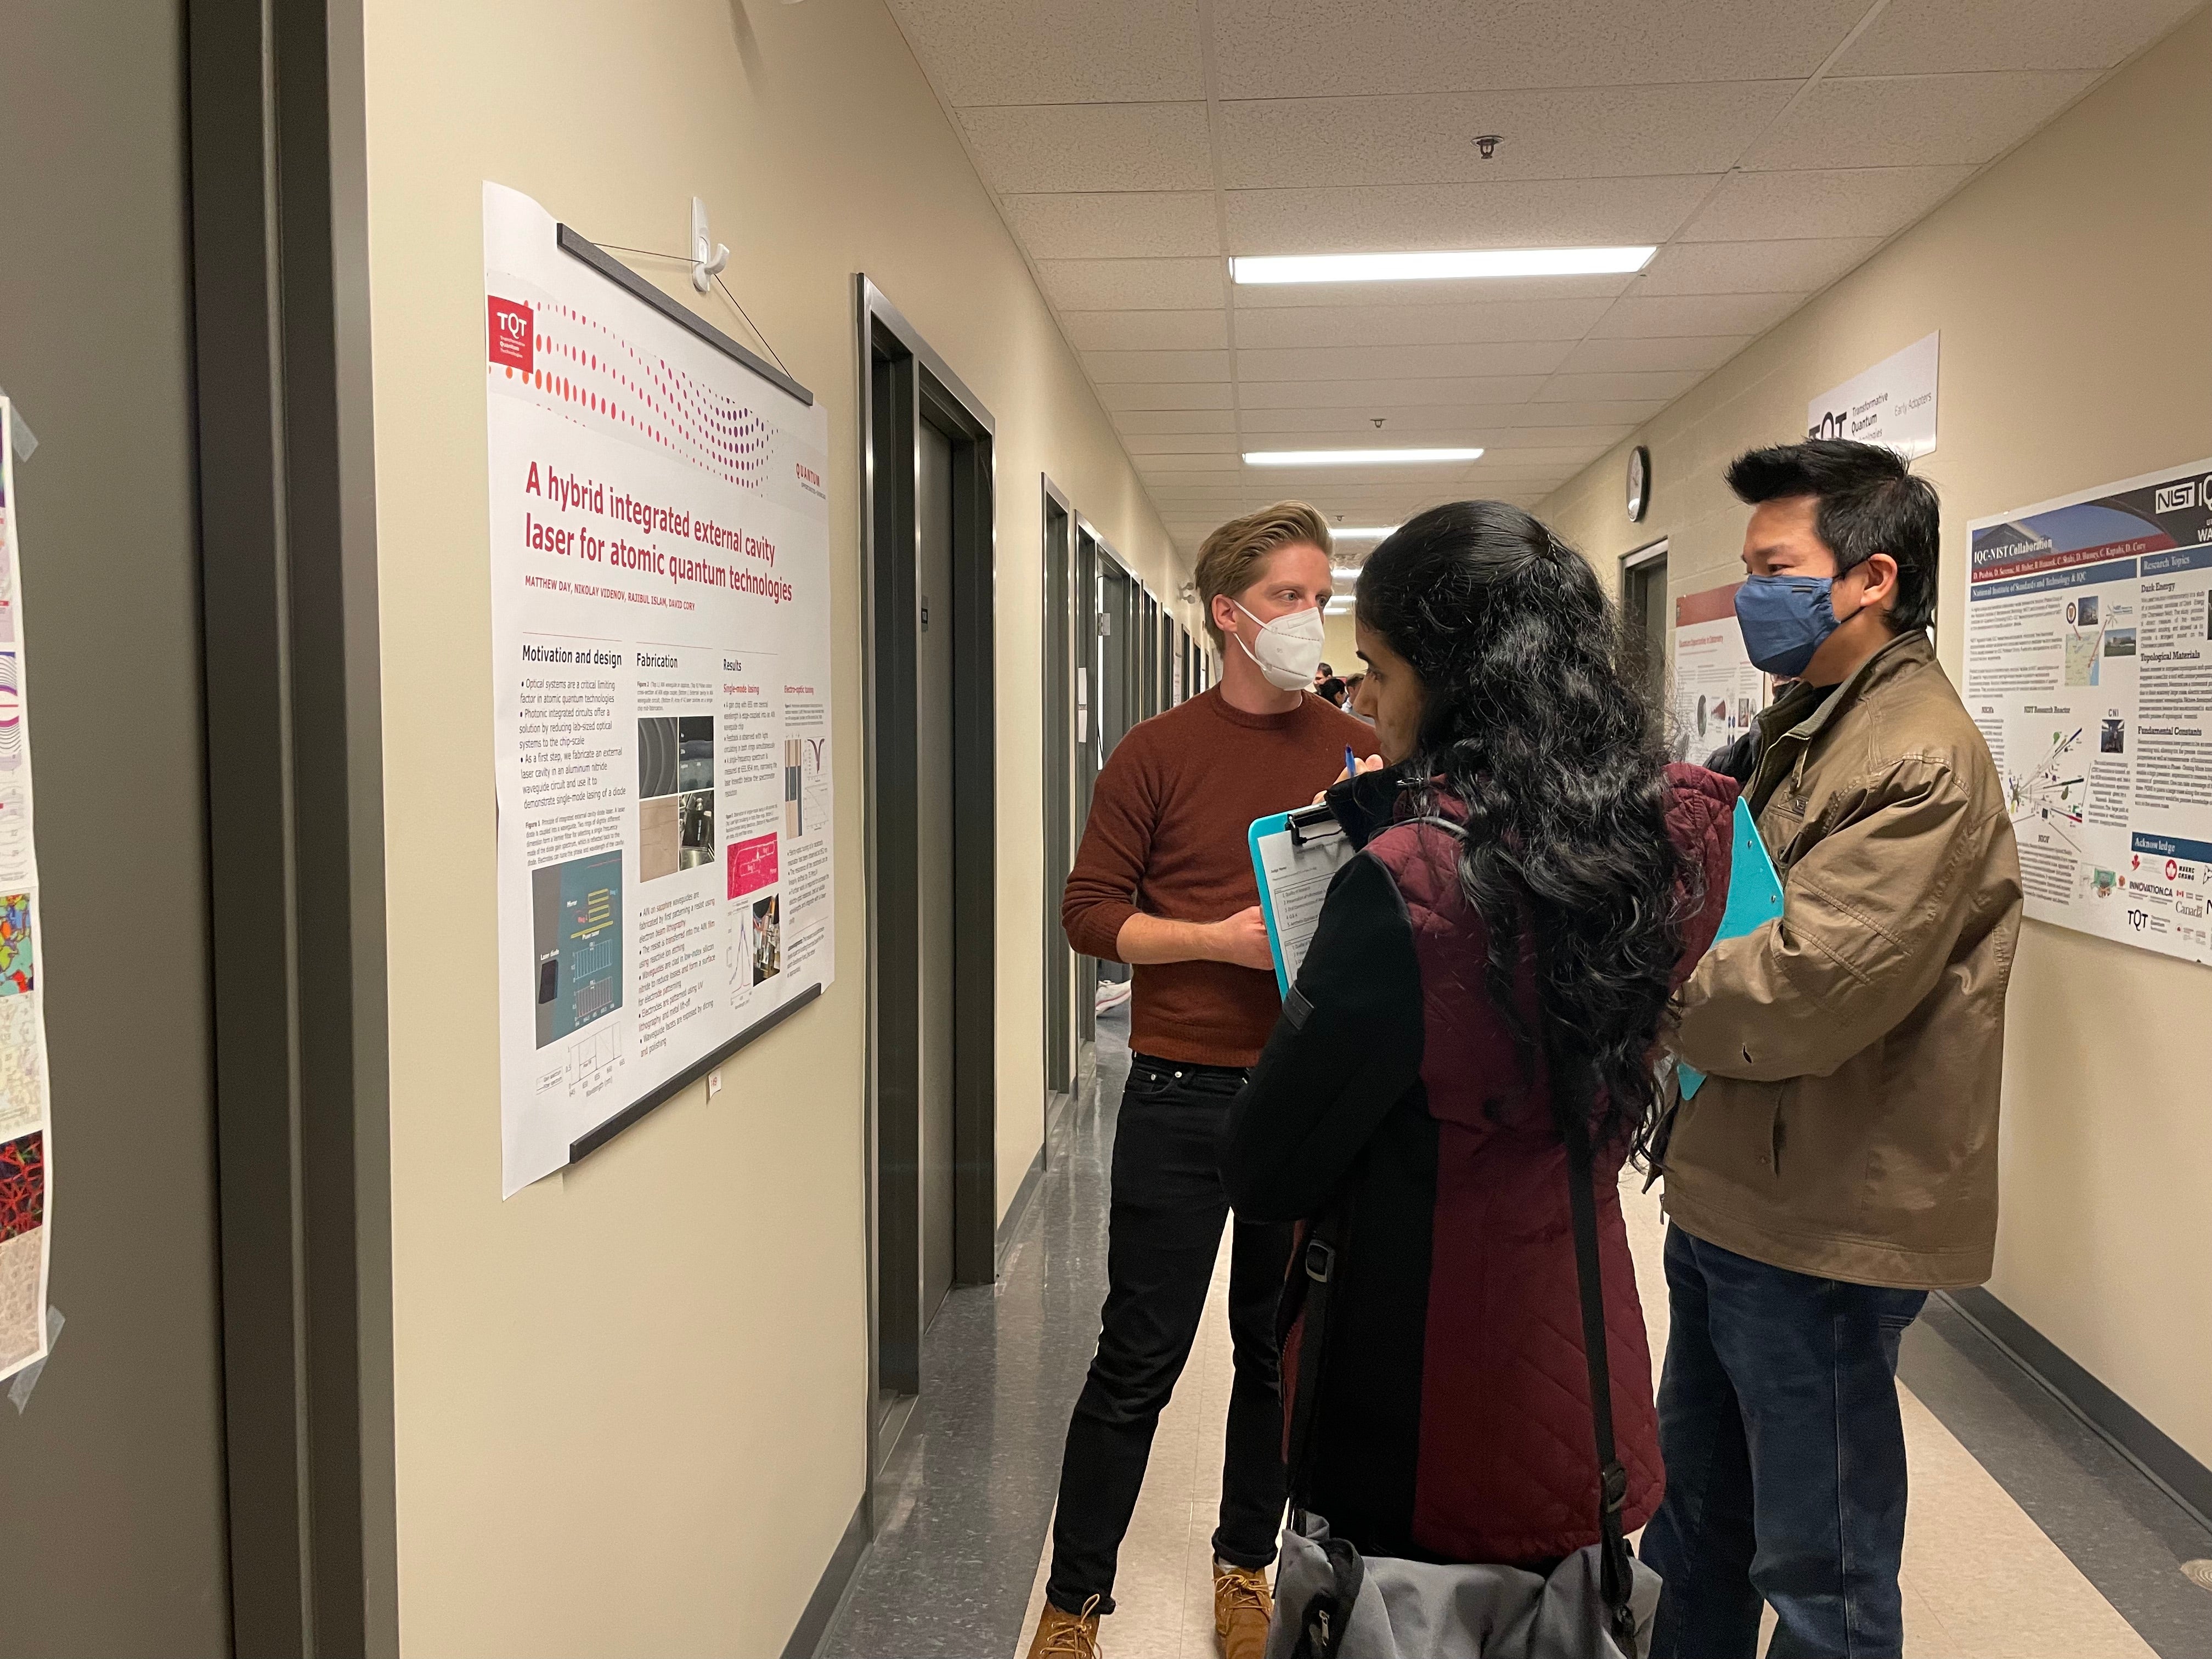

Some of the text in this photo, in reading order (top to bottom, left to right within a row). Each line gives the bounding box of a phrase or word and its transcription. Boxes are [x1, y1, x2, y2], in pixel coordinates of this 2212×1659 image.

[496, 312, 527, 339] TQT
[1853, 393, 1888, 417] Transformative
[1894, 403, 1907, 417] Early
[1909, 392, 1932, 409] Adopters
[1852, 414, 1877, 437] Quantum
[796, 463, 820, 487] QUANTUM
[2158, 486, 2192, 510] NIST
[526, 461, 775, 567] A hybrid integrated external cavity
[526, 512, 792, 603] laser for atomic quantum technologies
[1974, 538, 2052, 565] IQC-NIST Collaboration
[2143, 556, 2190, 571] Research Topics
[525, 575, 695, 611] MATTHEW DAY, NIKOLAY VIDENOV, RAJIBUL ISLAM, DAVID CORY
[2141, 582, 2175, 592] Dark Energy
[522, 645, 622, 668] Motivation and design
[636, 652, 678, 668] Fabrication
[724, 658, 741, 672] Results
[2141, 650, 2200, 663] Topological Materials
[526, 679, 544, 690] Optical
[546, 680, 566, 690] systems
[581, 680, 596, 689] critical
[597, 680, 615, 691] limiting
[521, 693, 614, 704] factor in atomic quantum technologies
[524, 708, 547, 718] Photonic
[549, 708, 573, 719] integrated
[575, 708, 592, 716] circuits
[594, 707, 605, 716] offer
[520, 721, 612, 734] solution by reducing lab-sized optical
[2138, 726, 2202, 736] Fundamental Constants
[520, 736, 584, 751] systems to the chip-scale
[525, 754, 532, 763] As
[538, 752, 548, 762] first
[550, 752, 562, 762] step,
[573, 750, 594, 759] fabricate
[603, 747, 622, 757] external
[521, 768, 533, 779] laser
[535, 768, 550, 778] cavity
[552, 767, 556, 775] in
[566, 764, 590, 774] aluminum
[592, 762, 607, 771] nitride
[522, 782, 549, 794] waveguide
[551, 780, 565, 790] circuit
[567, 778, 575, 788] and
[587, 777, 590, 785] it
[524, 795, 555, 809] demonstrate
[557, 792, 585, 805] single-mode
[586, 790, 600, 800] lasing
[602, 788, 607, 797] of
[613, 786, 625, 795] diode
[2130, 881, 2172, 897] INNOVATION.CA
[2176, 901, 2202, 918] Canada
[2128, 910, 2148, 931] TQT
